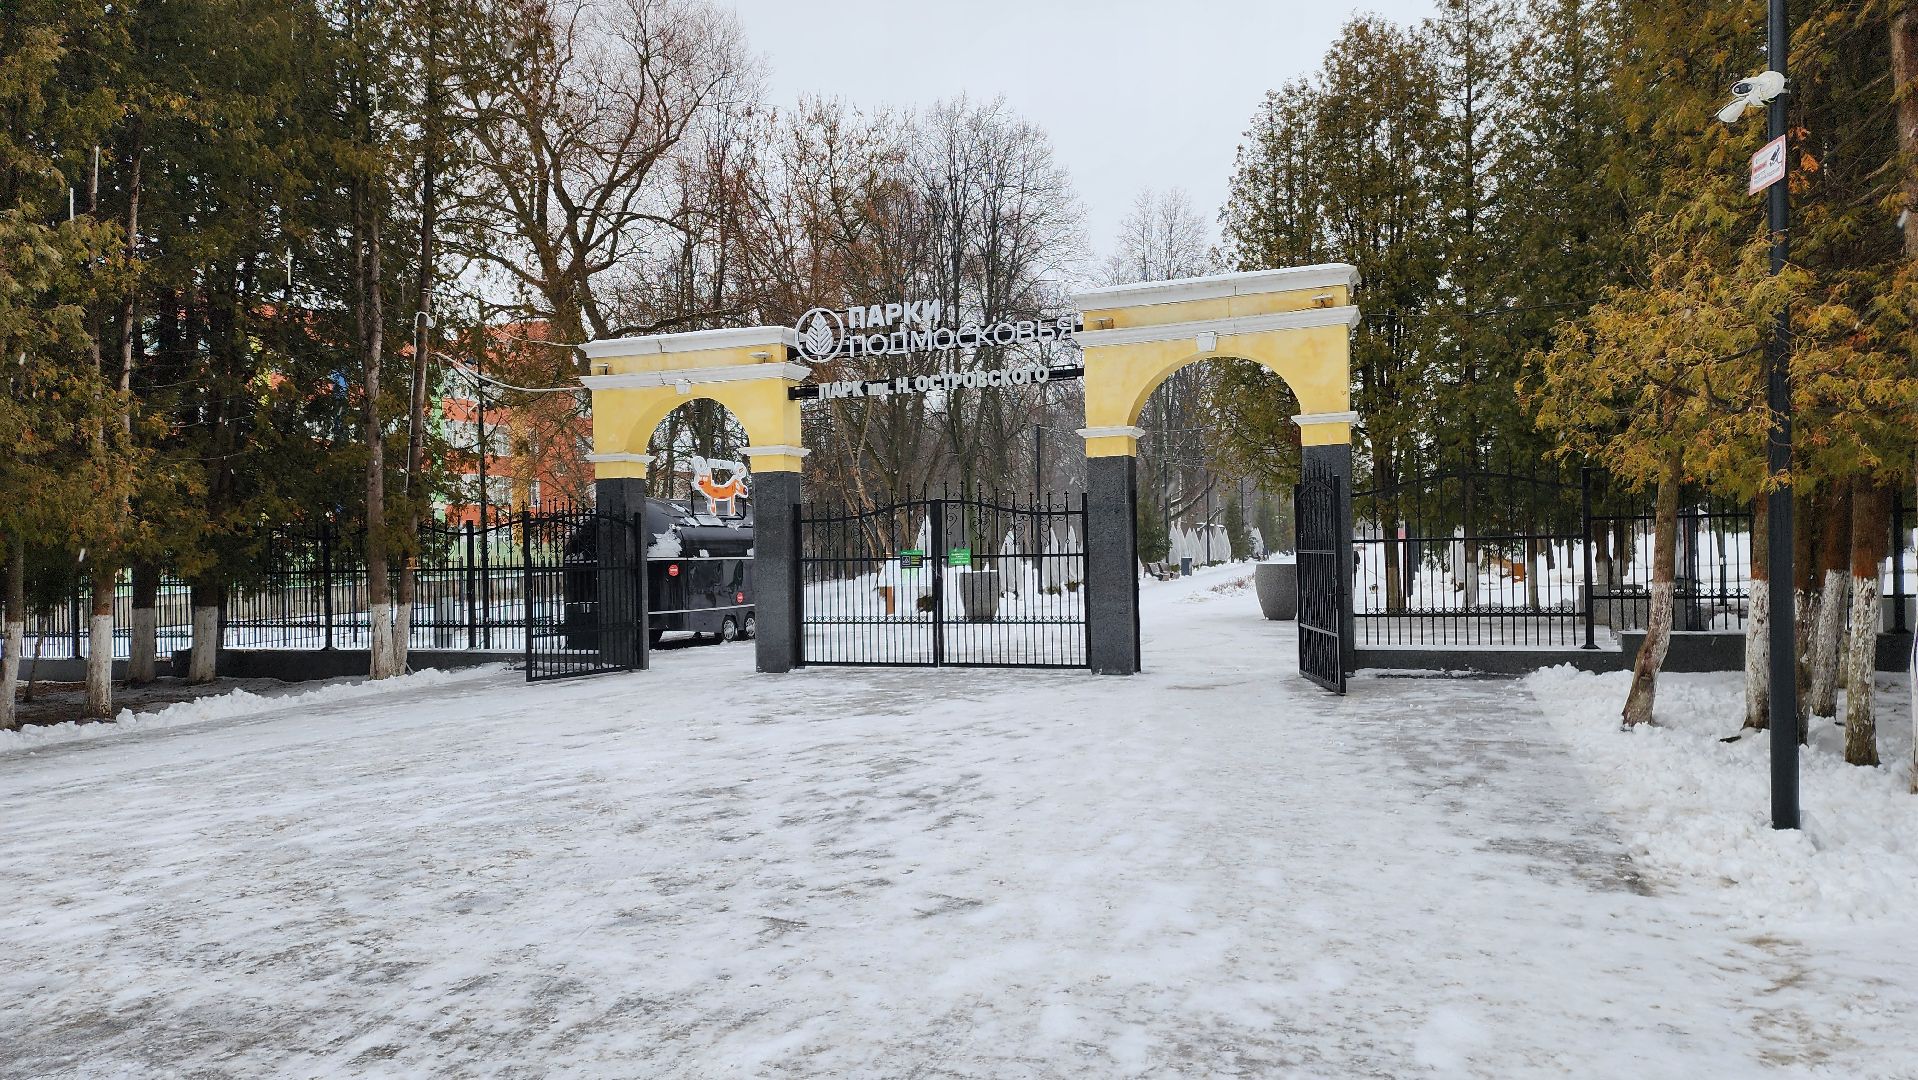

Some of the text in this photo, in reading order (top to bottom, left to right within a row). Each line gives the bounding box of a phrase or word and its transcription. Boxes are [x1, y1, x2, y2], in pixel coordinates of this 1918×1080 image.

[849, 300, 940, 328] ПАРКИ
[850, 316, 1075, 357] ПОДМОСКОВЬЯ
[818, 380, 863, 400] ПАРК
[896, 377, 913, 394] Н.
[915, 366, 1050, 392] ОСТРОВСКОГО
